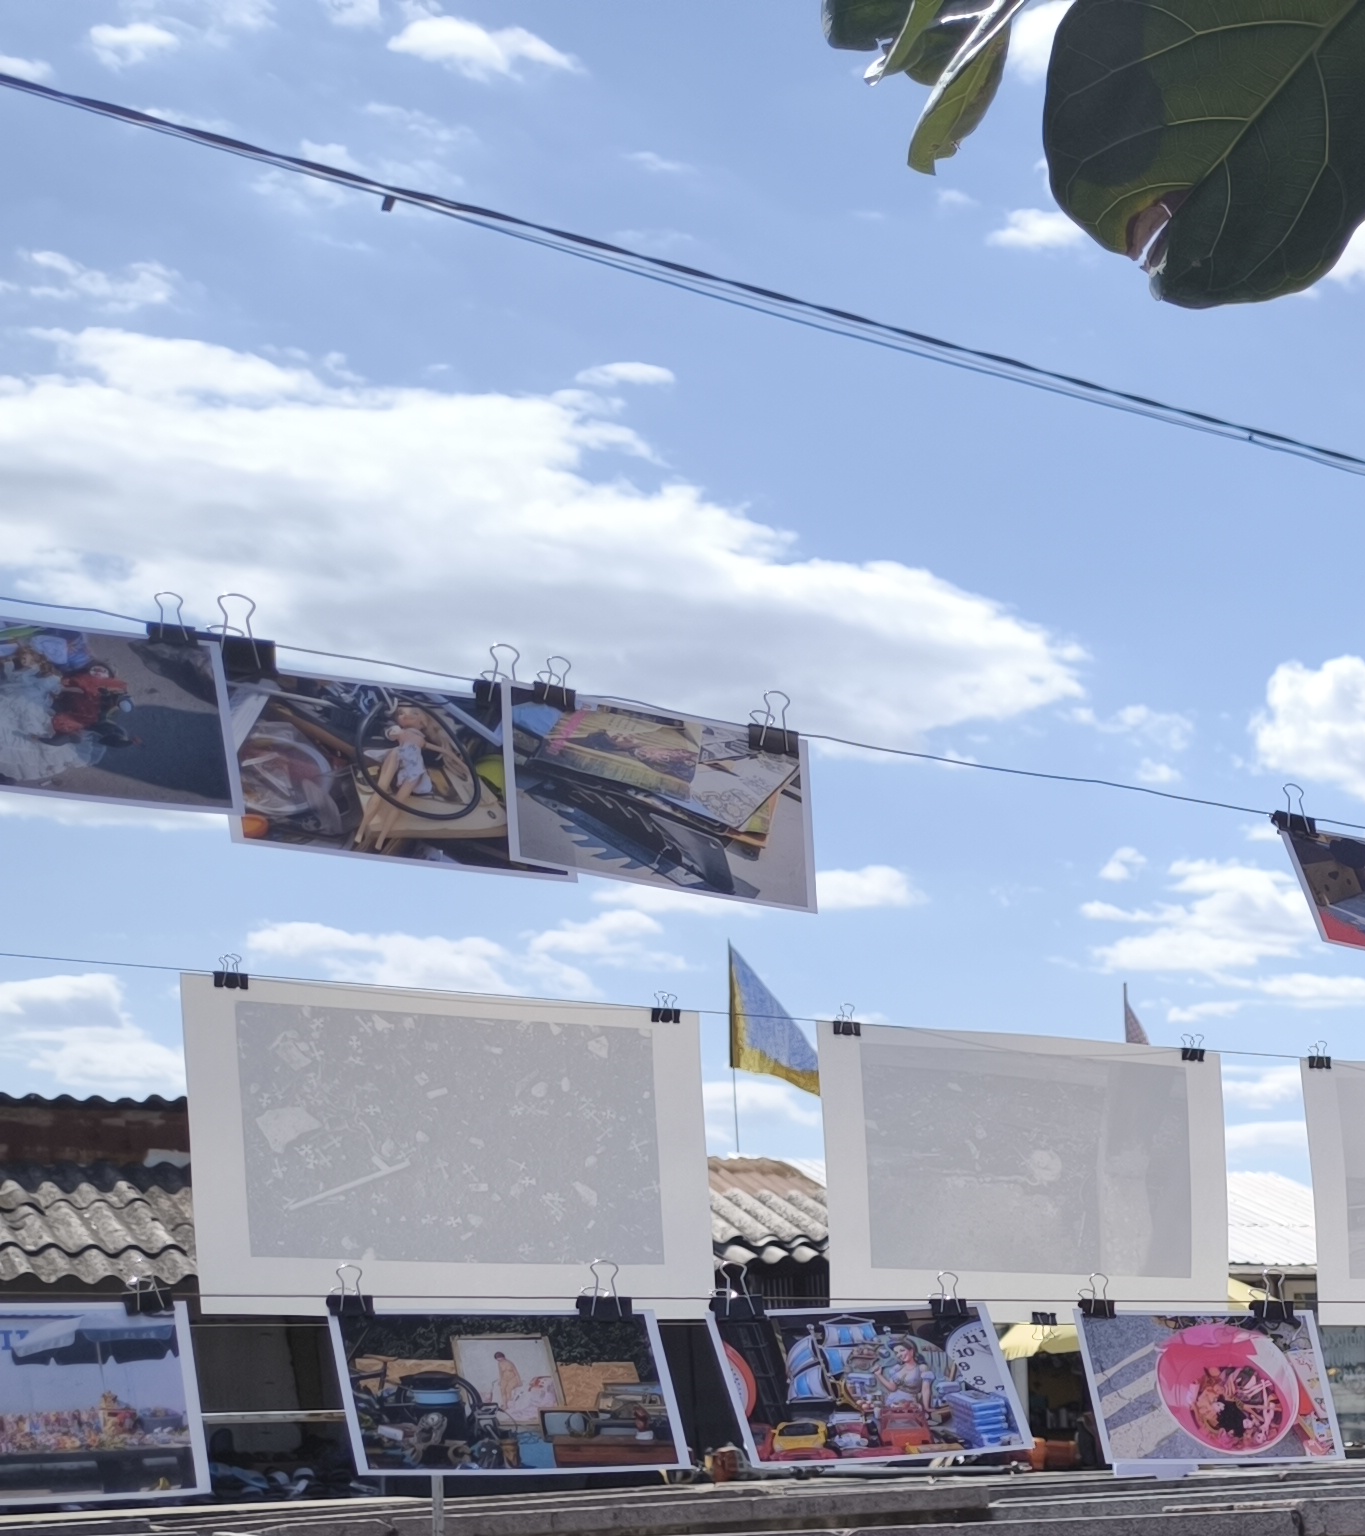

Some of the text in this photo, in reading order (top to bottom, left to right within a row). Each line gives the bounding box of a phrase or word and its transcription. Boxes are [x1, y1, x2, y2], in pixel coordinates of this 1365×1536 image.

[956, 1347, 975, 1358] 10
[958, 1362, 971, 1371] 9
[973, 1376, 986, 1386] 8
